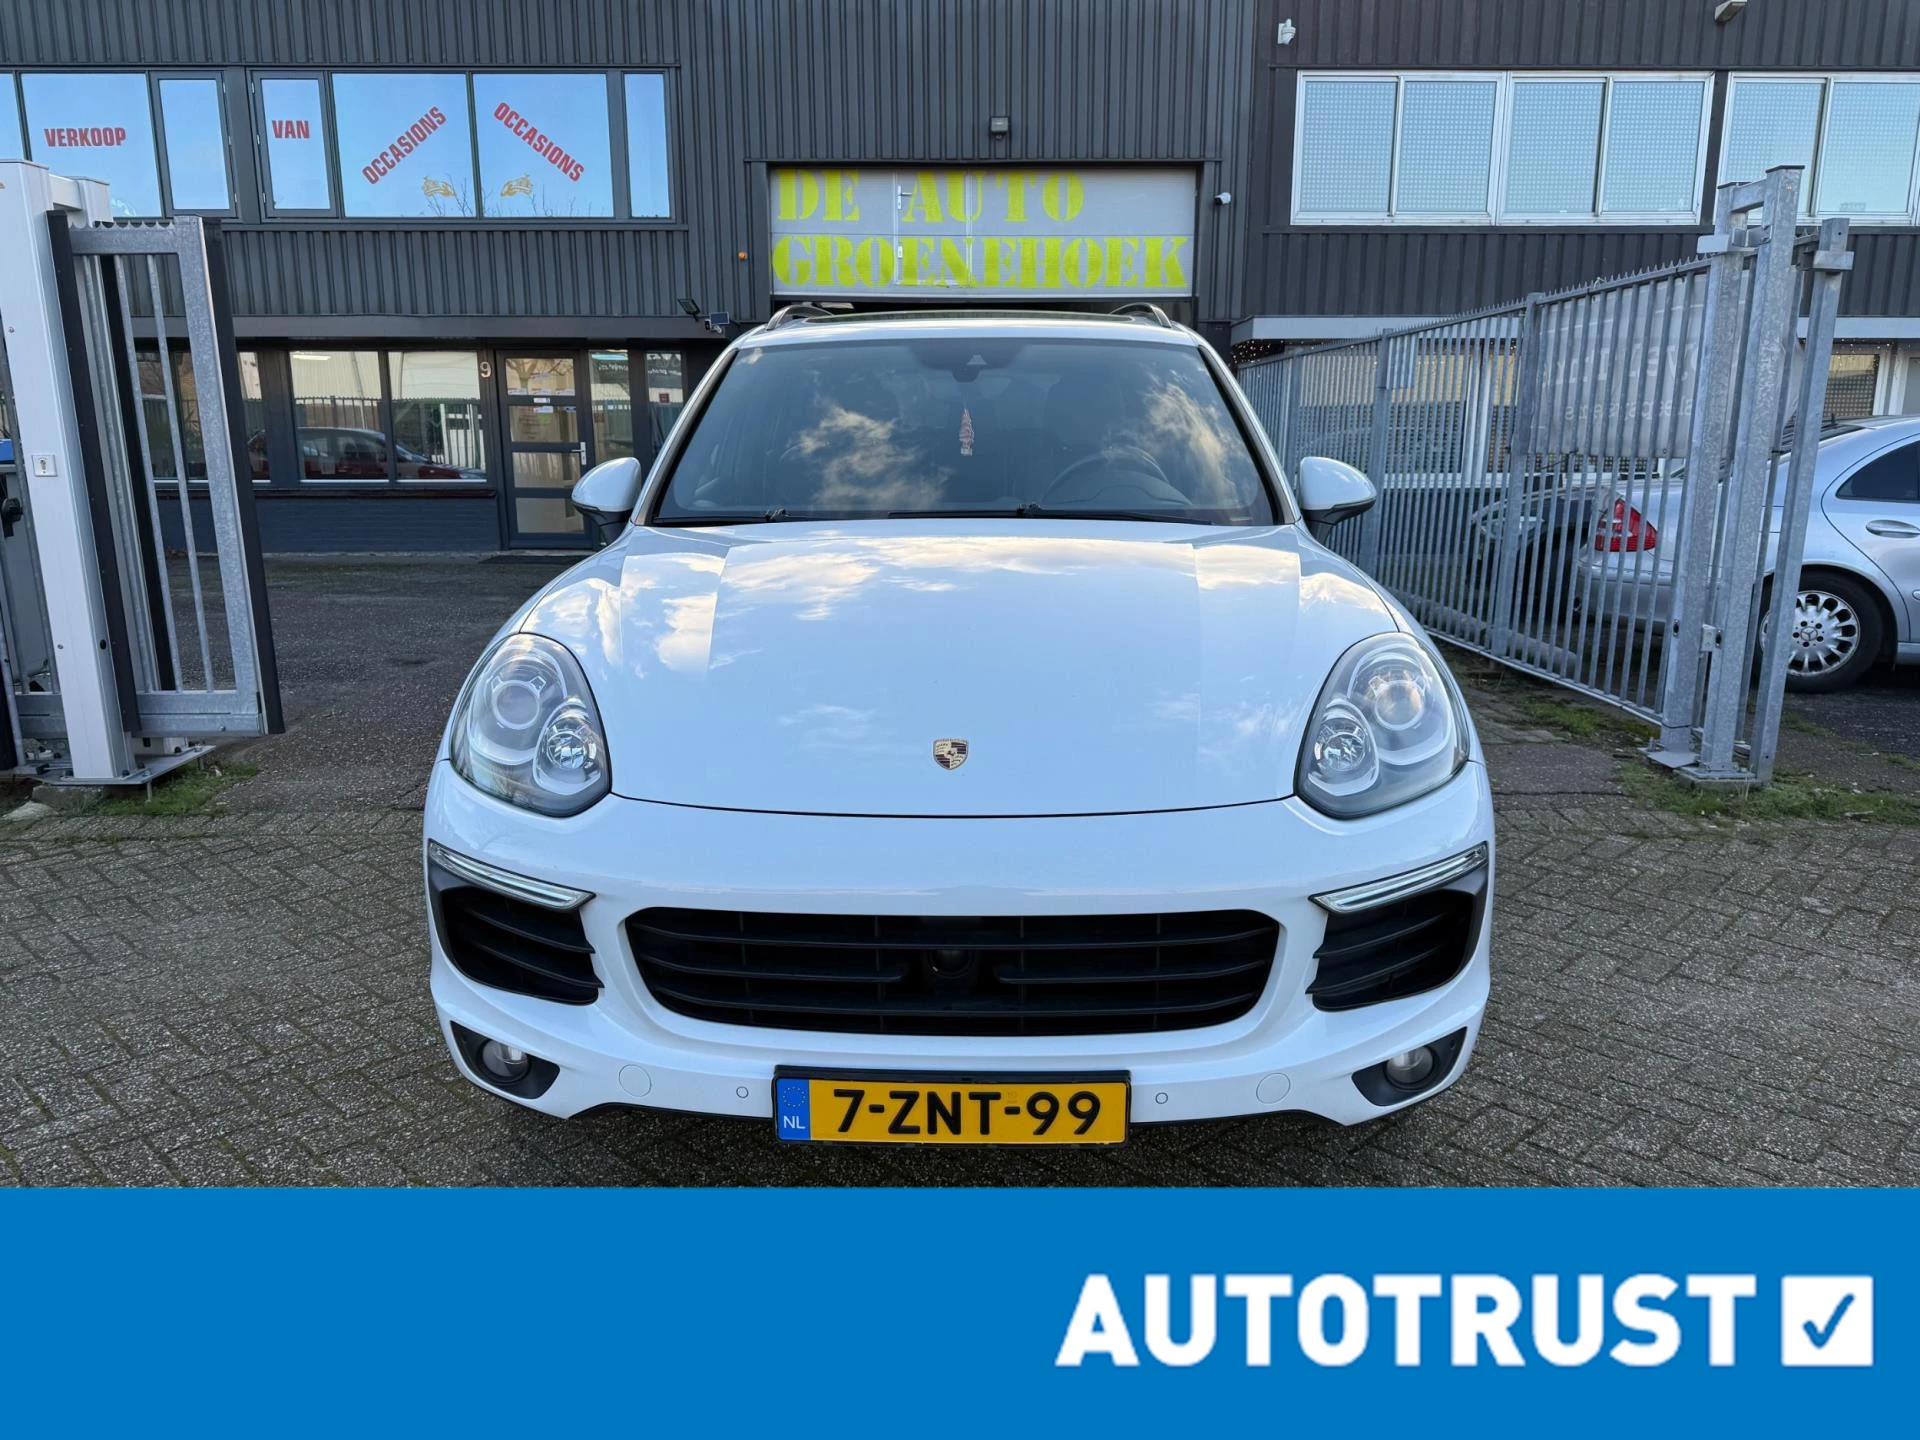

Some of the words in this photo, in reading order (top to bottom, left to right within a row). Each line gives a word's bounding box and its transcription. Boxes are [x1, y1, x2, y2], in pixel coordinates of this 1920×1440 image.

[44, 127, 127, 148] VERKOOP
[271, 120, 311, 140] VAN
[361, 105, 448, 185] OCCASIONS
[493, 101, 585, 182] OCCASIONS
[776, 168, 860, 222] DE
[900, 169, 1085, 223] AUTO
[772, 235, 1189, 289] GROENEHOEK
[480, 361, 491, 378] 9
[783, 1115, 806, 1129] NL
[833, 1088, 1101, 1136] 7-ZNT-99
